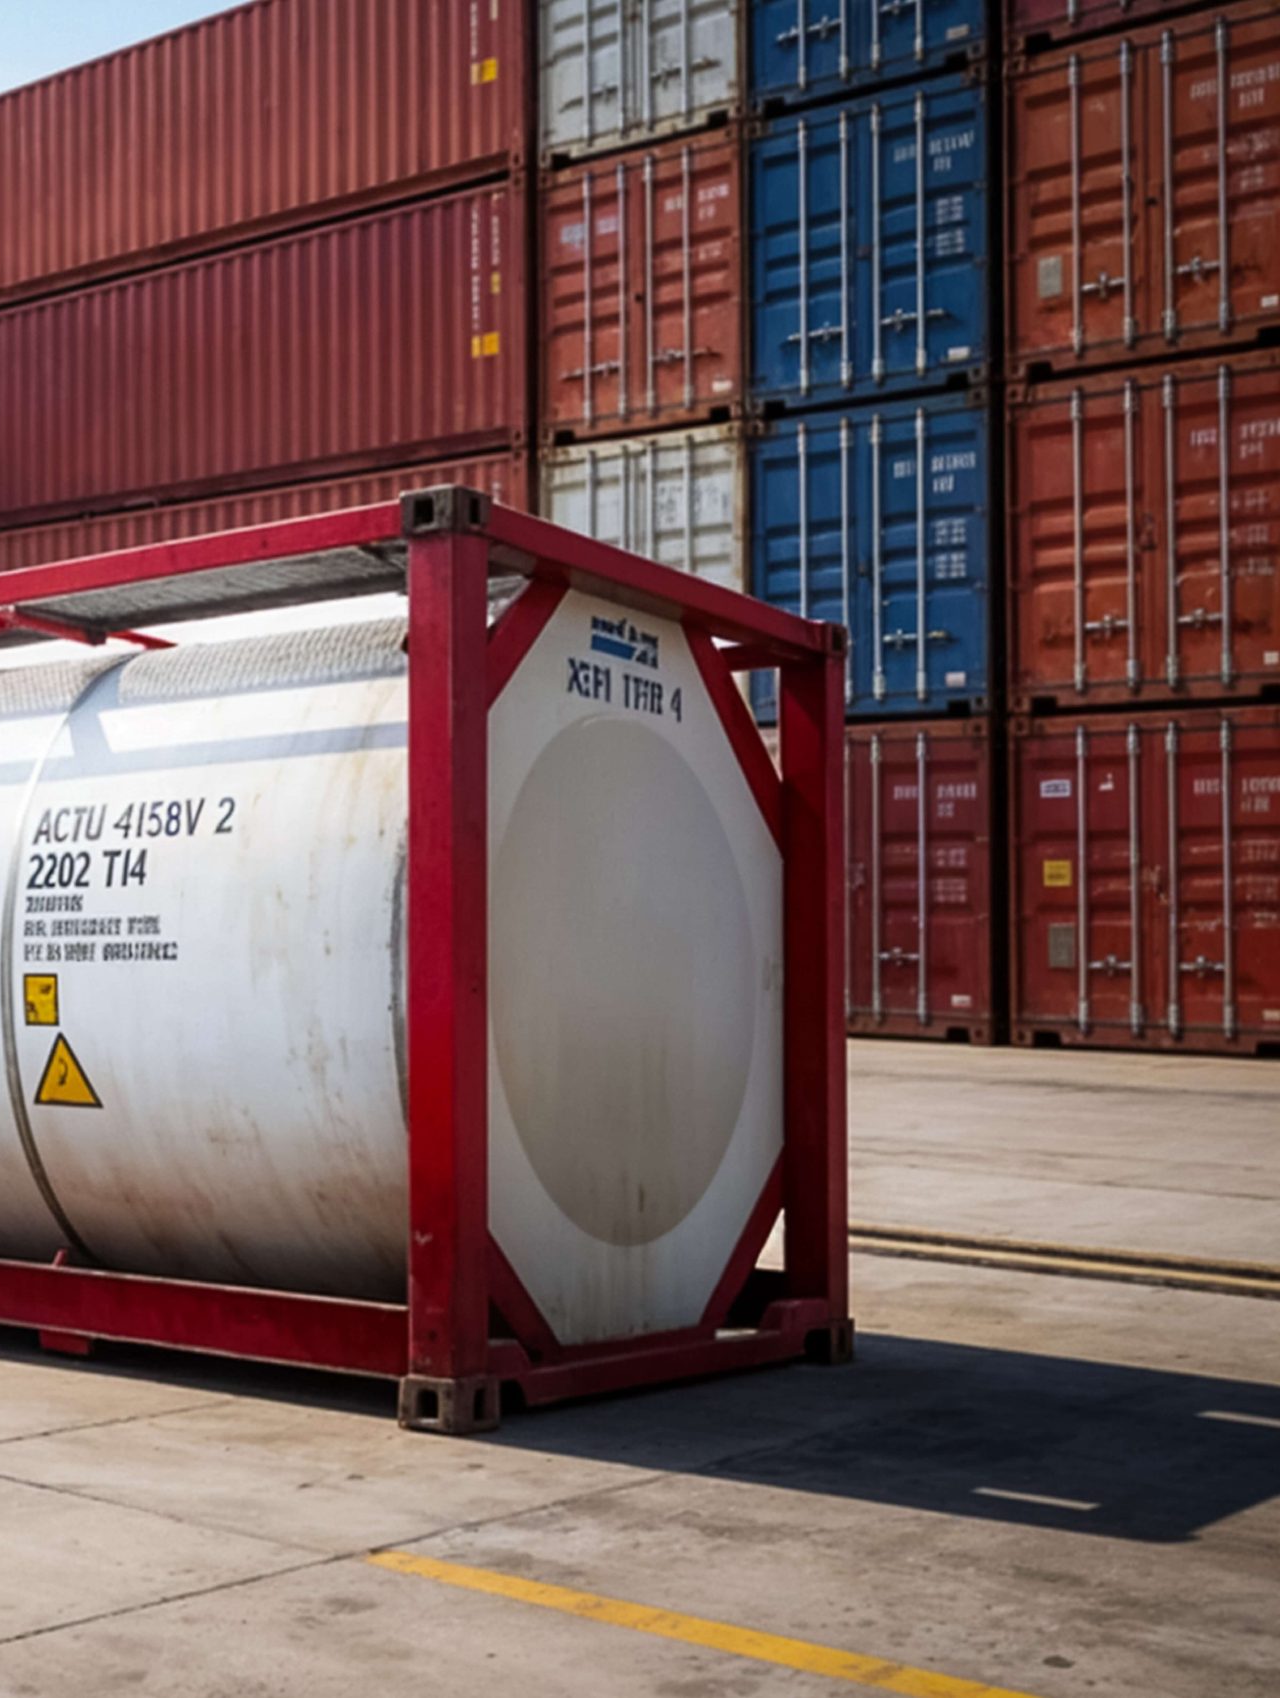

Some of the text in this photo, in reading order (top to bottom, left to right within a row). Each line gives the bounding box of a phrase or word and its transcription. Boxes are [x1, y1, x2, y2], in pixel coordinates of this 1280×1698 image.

[32, 796, 236, 845] ACTU 4158V 2
[27, 848, 148, 890] 2202 T14
